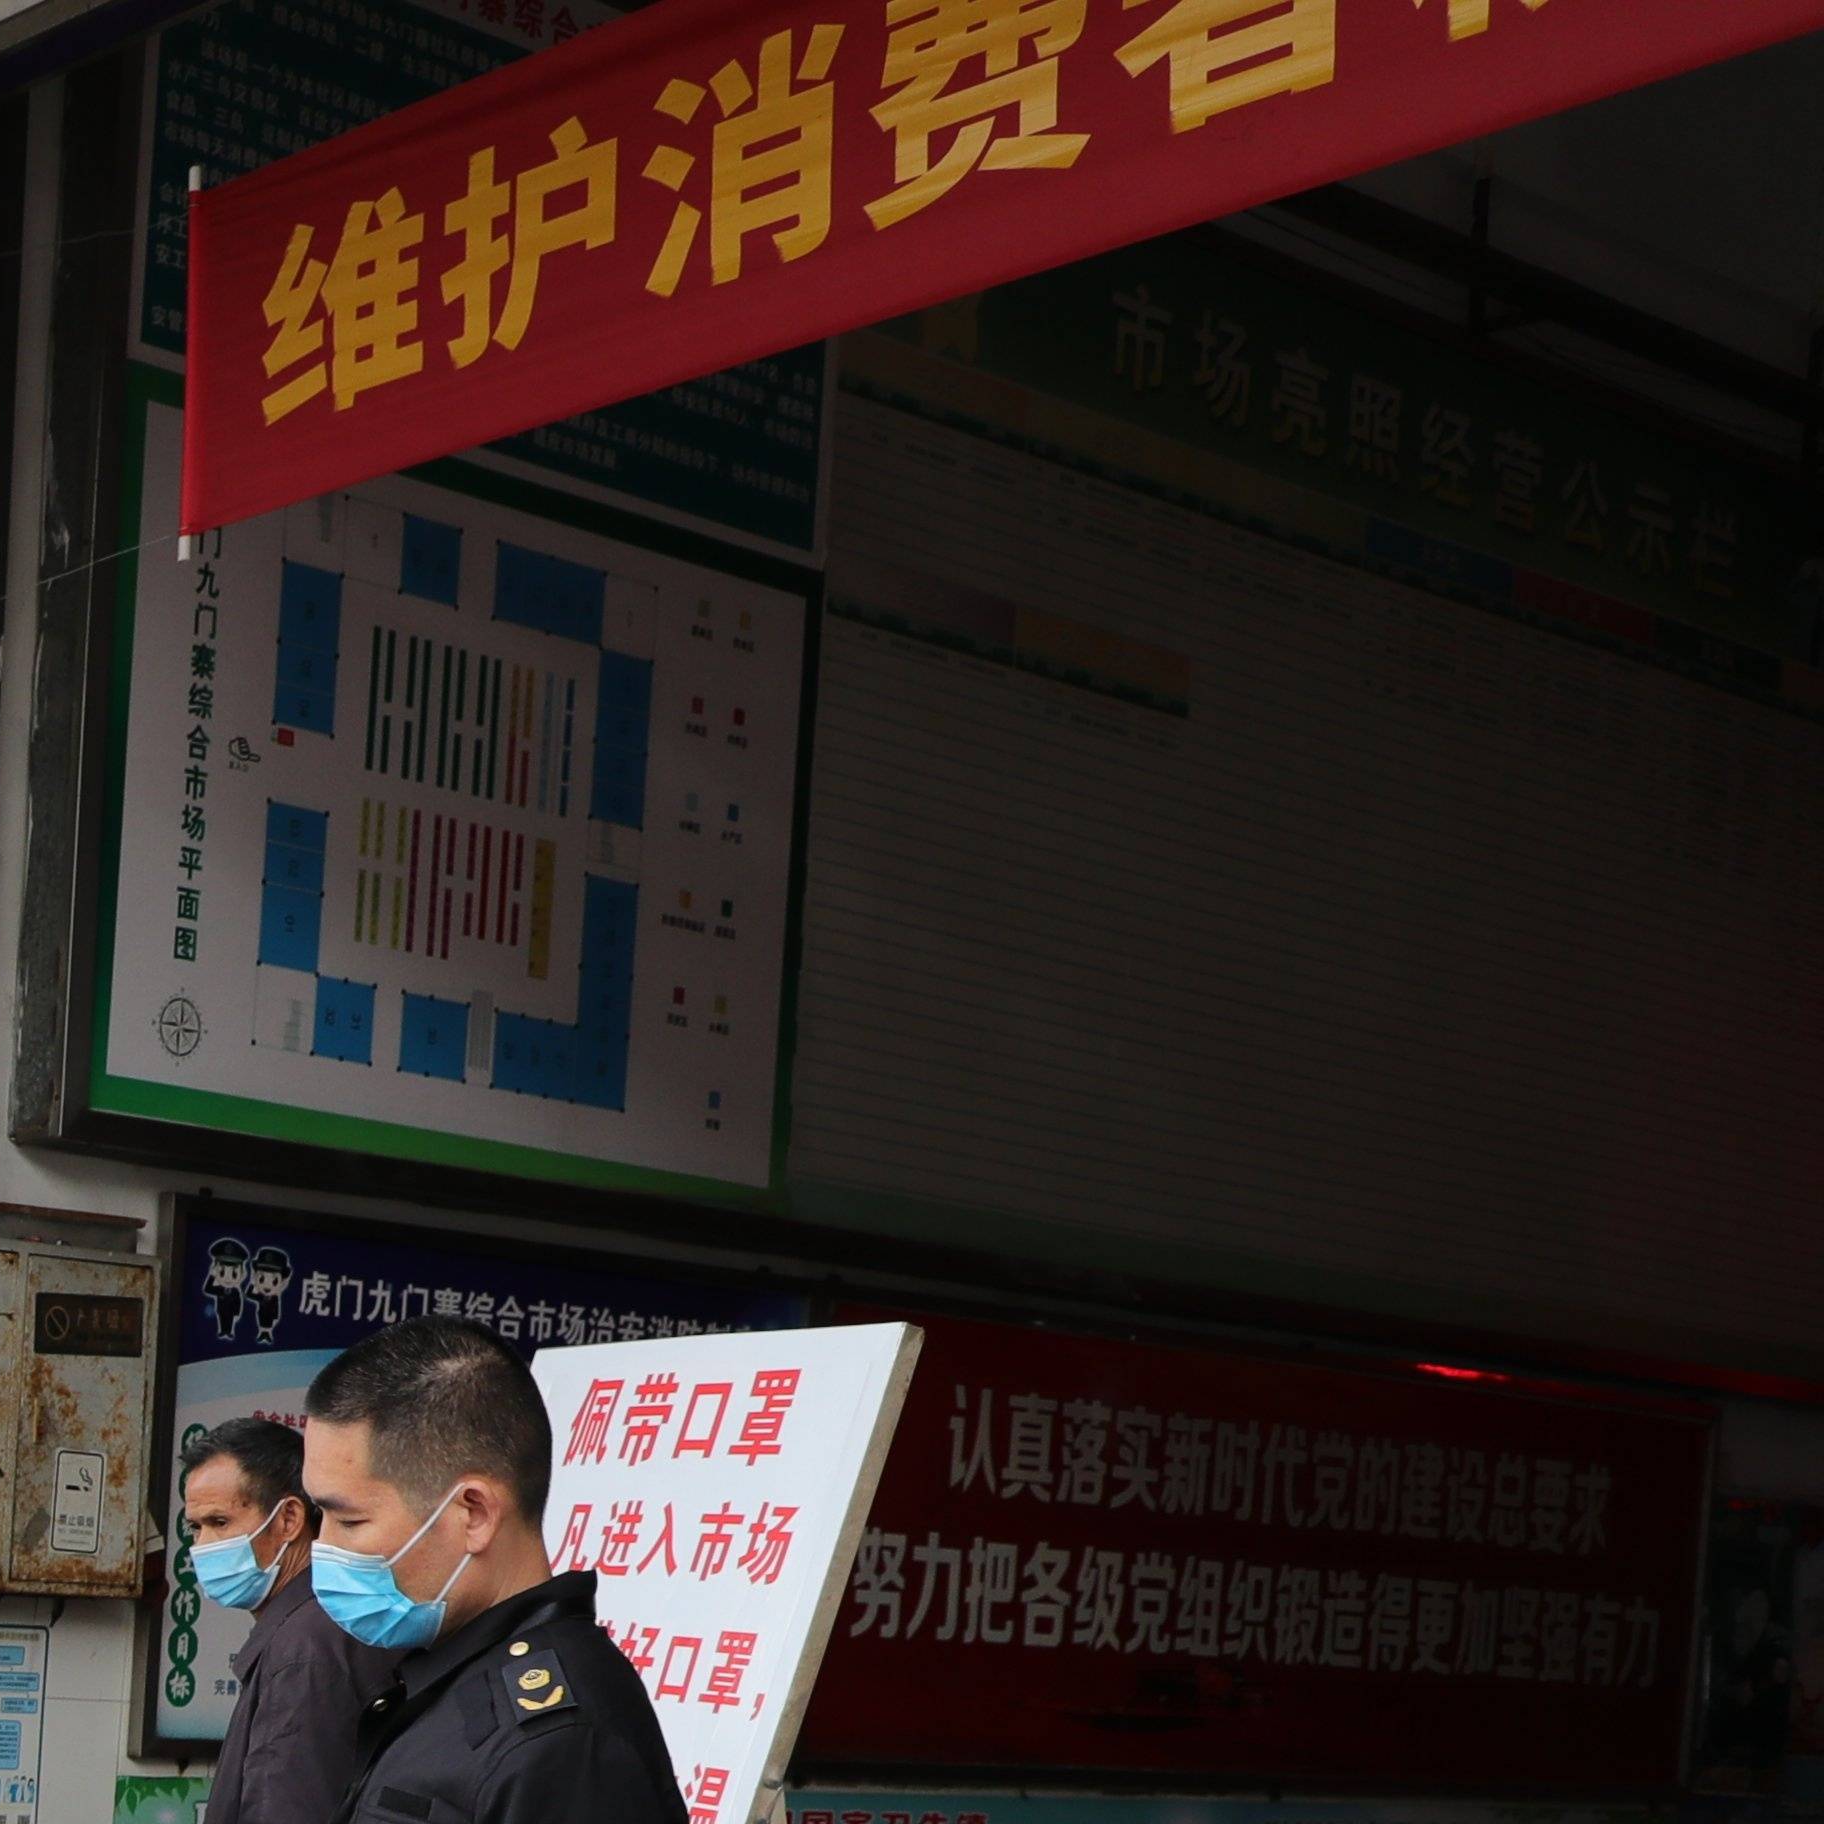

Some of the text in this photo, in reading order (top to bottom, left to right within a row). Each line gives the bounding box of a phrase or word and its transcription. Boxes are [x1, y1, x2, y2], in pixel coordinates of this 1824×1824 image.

[261, 0, 1554, 428] 维护消费者
[1109, 283, 1747, 599] 市场亮照经营公示栏
[561, 1367, 802, 1468] 佩带口罩
[949, 1384, 1615, 1558] 认真落实新时代党的建设总要求
[551, 1500, 801, 1587] 凡进入市场
[847, 1526, 1668, 1690] 努力把各级党组织锻造得更加坚强有力
[595, 1619, 767, 1721] 好口罩，
